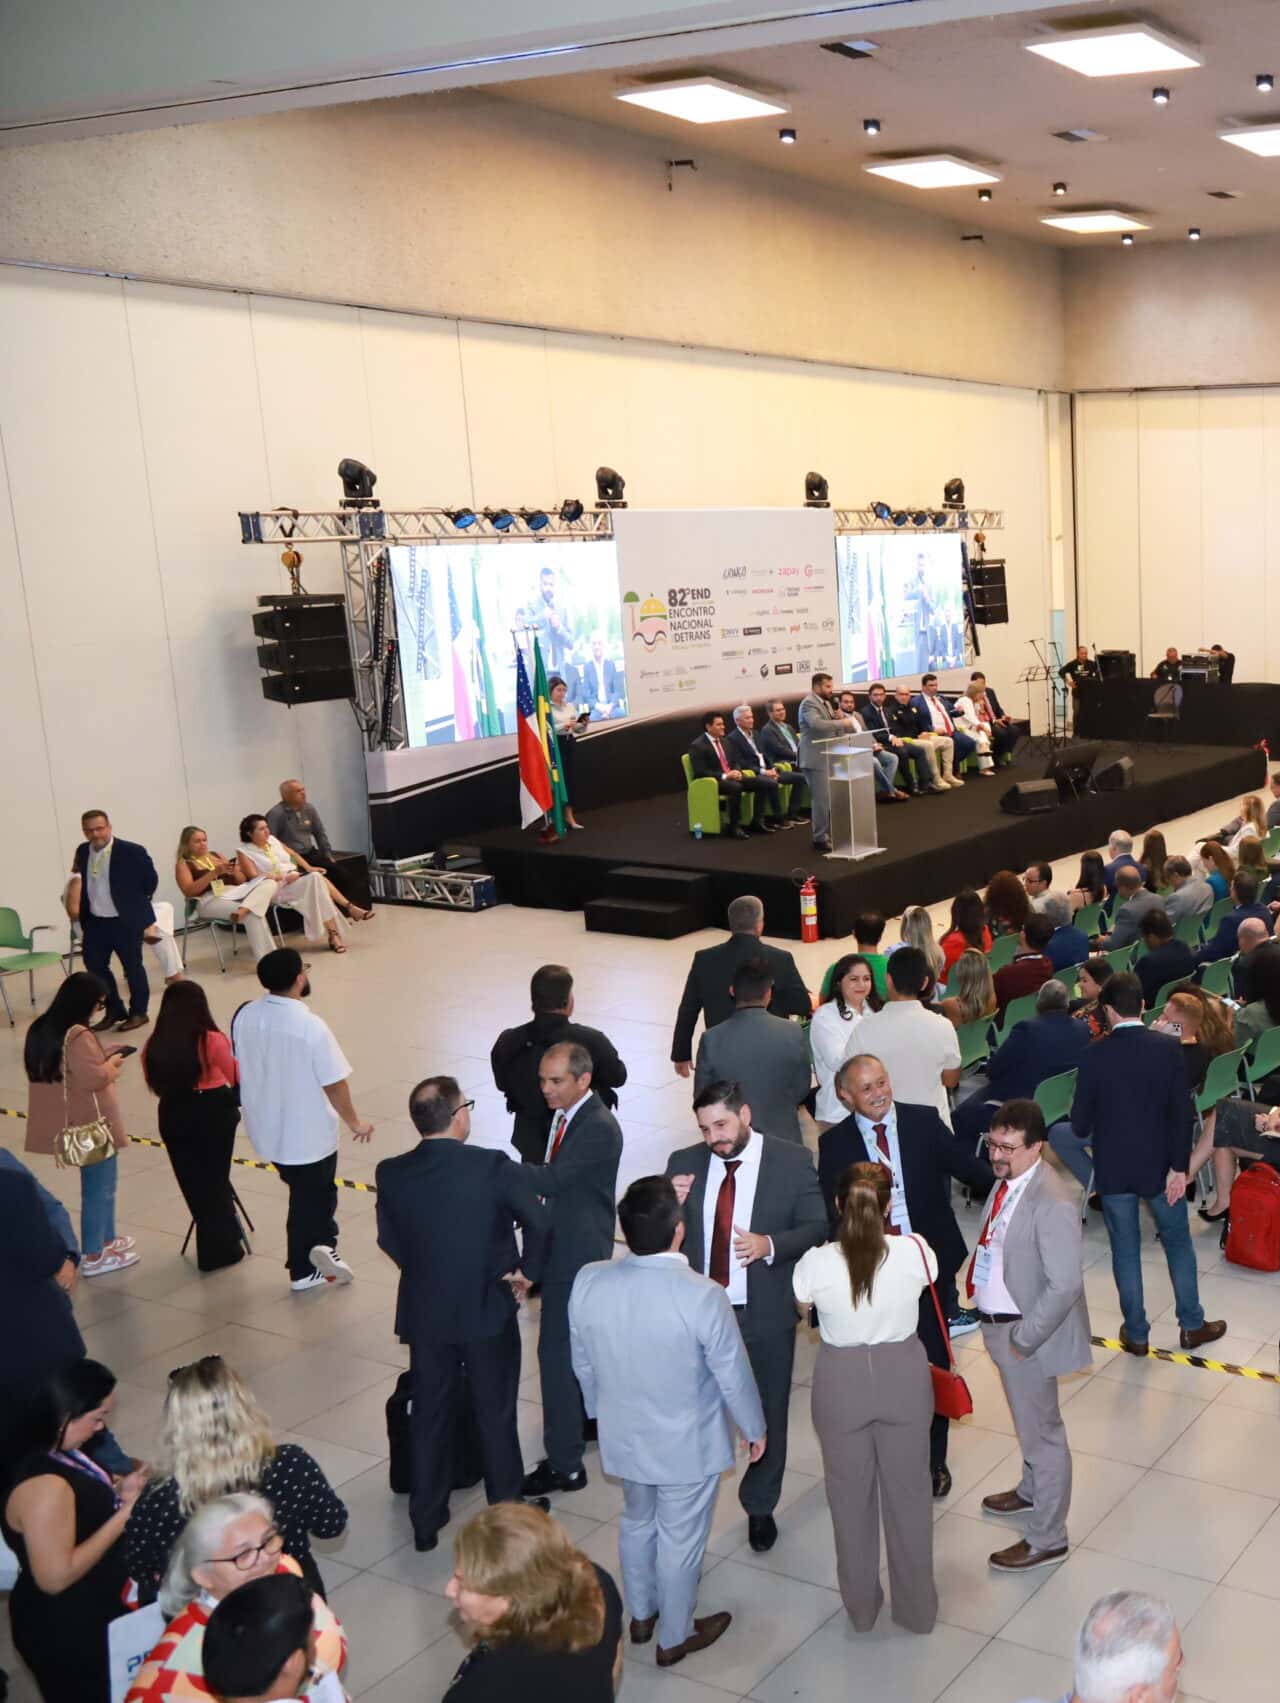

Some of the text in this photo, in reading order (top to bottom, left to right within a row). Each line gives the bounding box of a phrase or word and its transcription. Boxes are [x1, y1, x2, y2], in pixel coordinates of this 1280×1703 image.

[691, 587, 711, 600] END
[668, 606, 716, 619] ENCONTRO
[670, 618, 712, 631] NACIONAL
[674, 630, 711, 642] DETRANS
